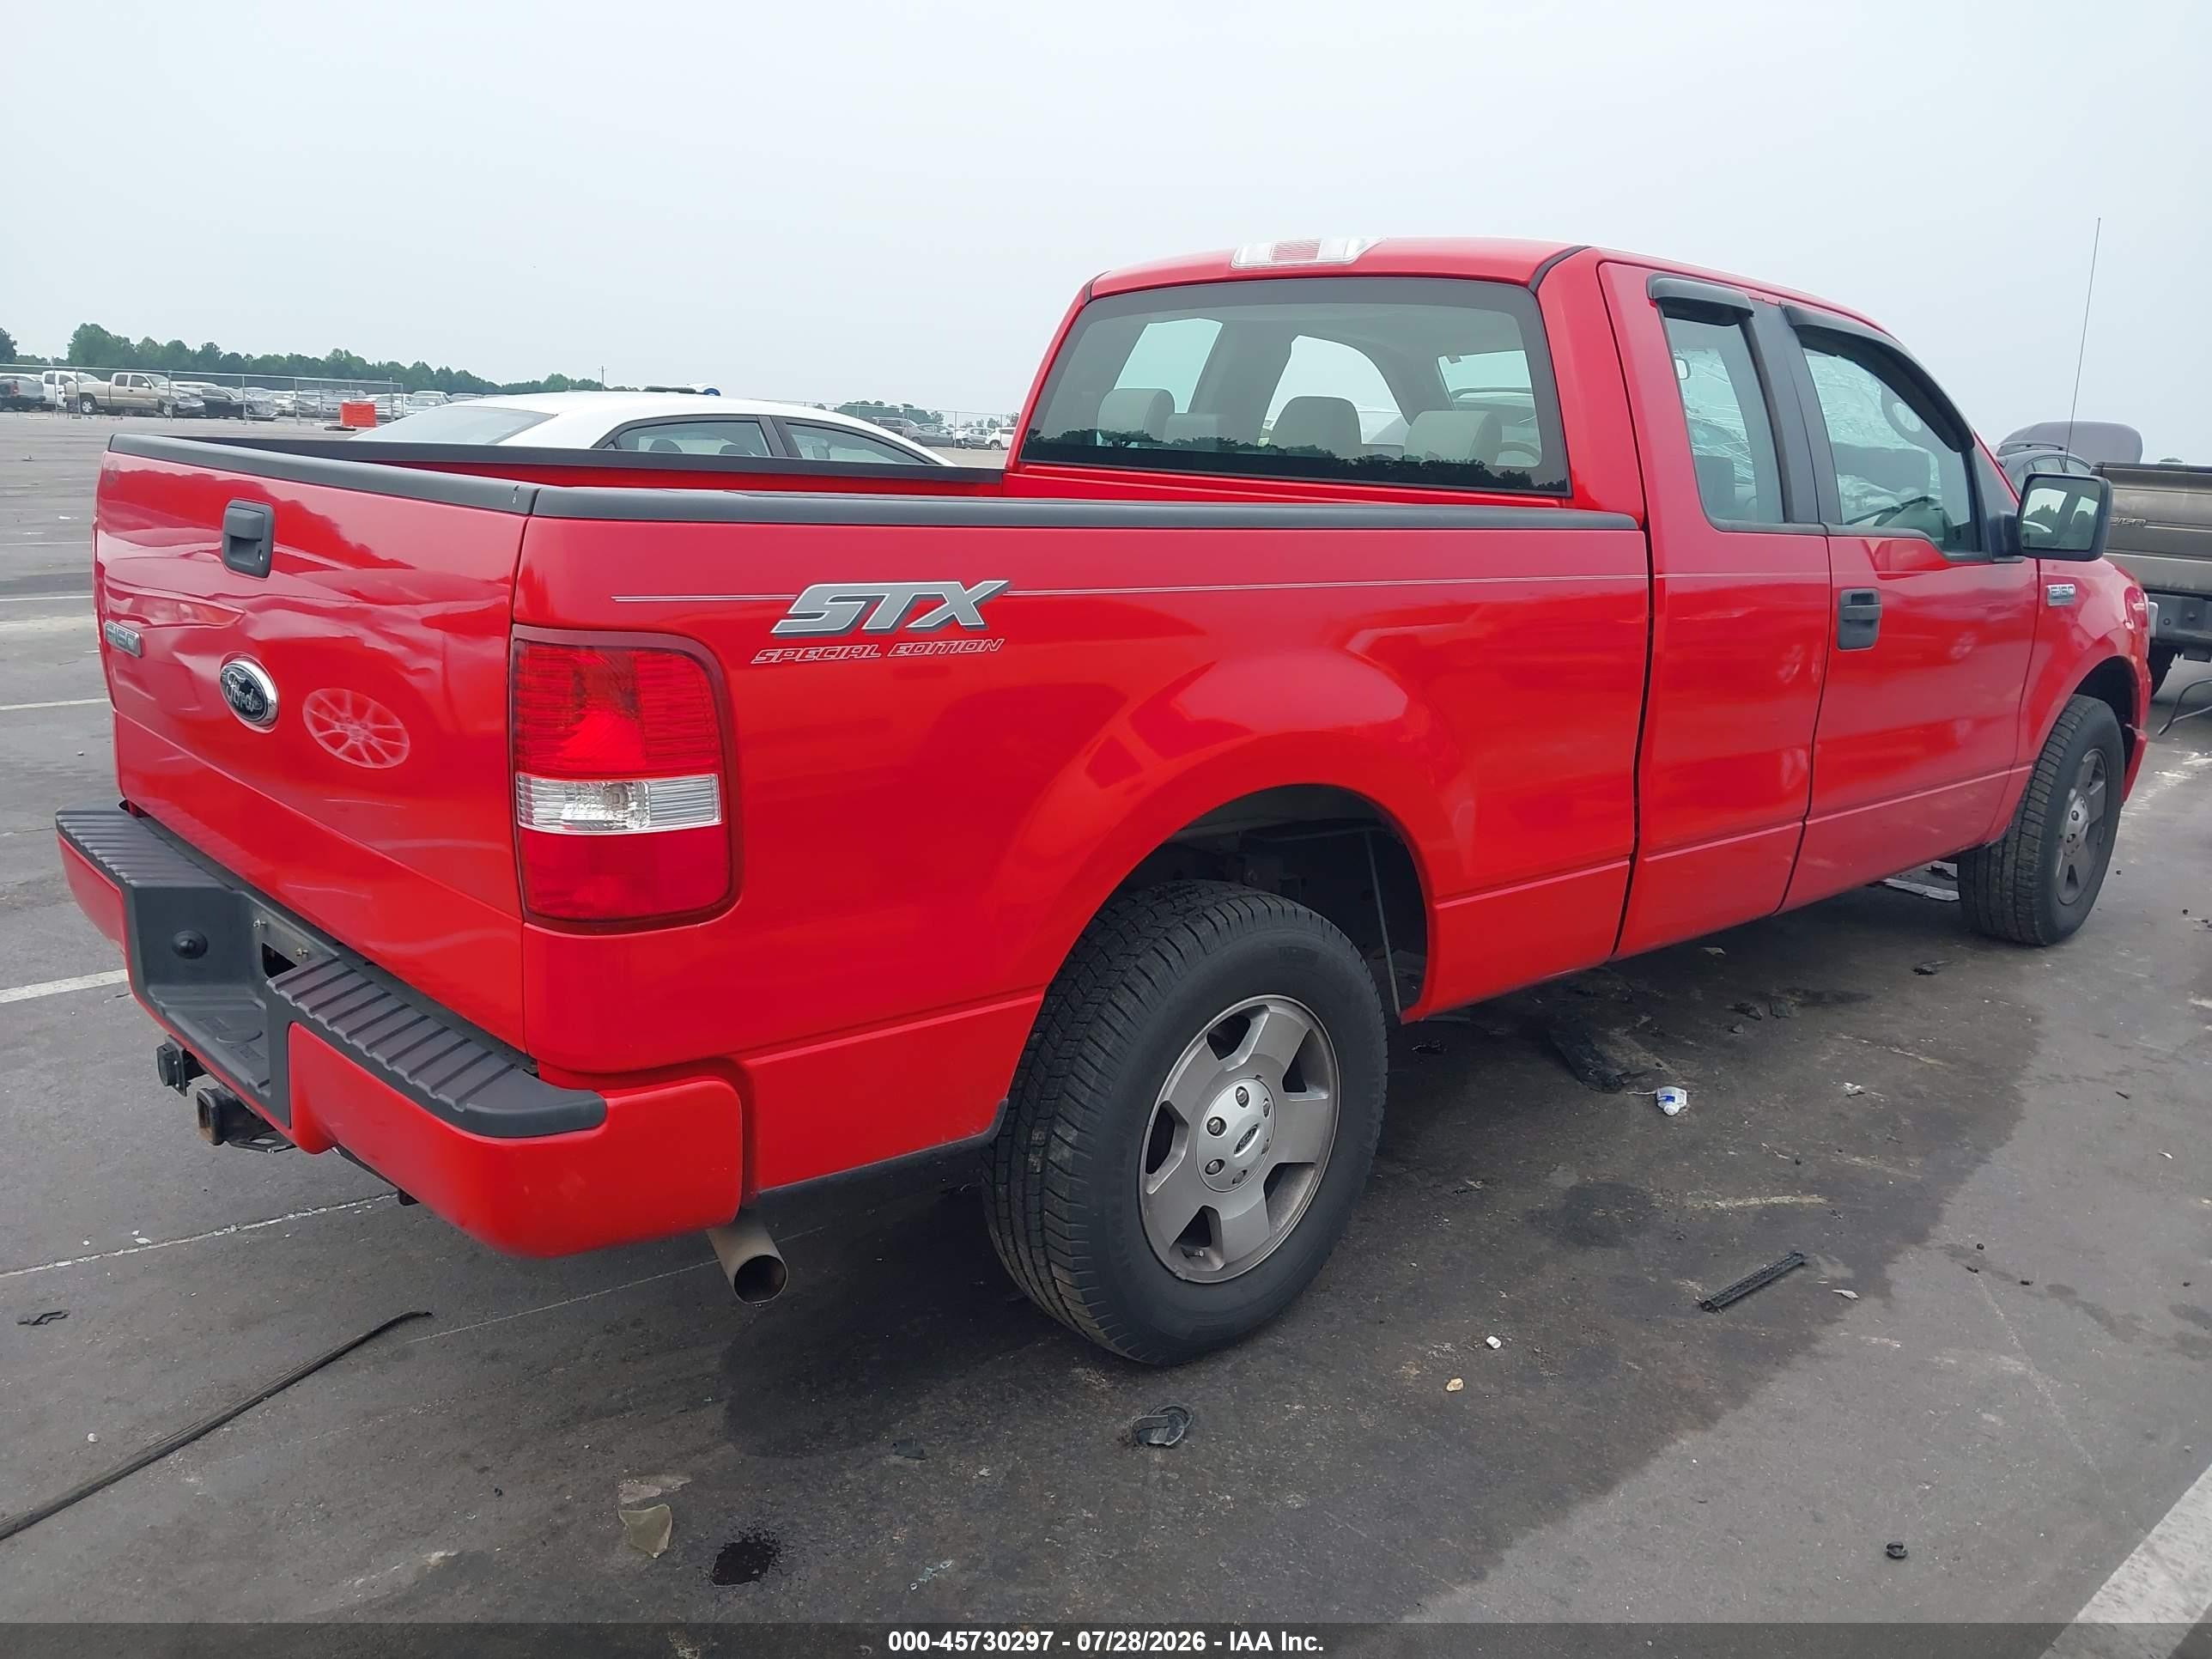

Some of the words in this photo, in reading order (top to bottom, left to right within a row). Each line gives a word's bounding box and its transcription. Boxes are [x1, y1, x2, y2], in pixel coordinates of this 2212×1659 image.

[771, 580, 1010, 637] STX
[750, 644, 882, 665] SPECIAL
[887, 638, 1005, 658] EDITION
